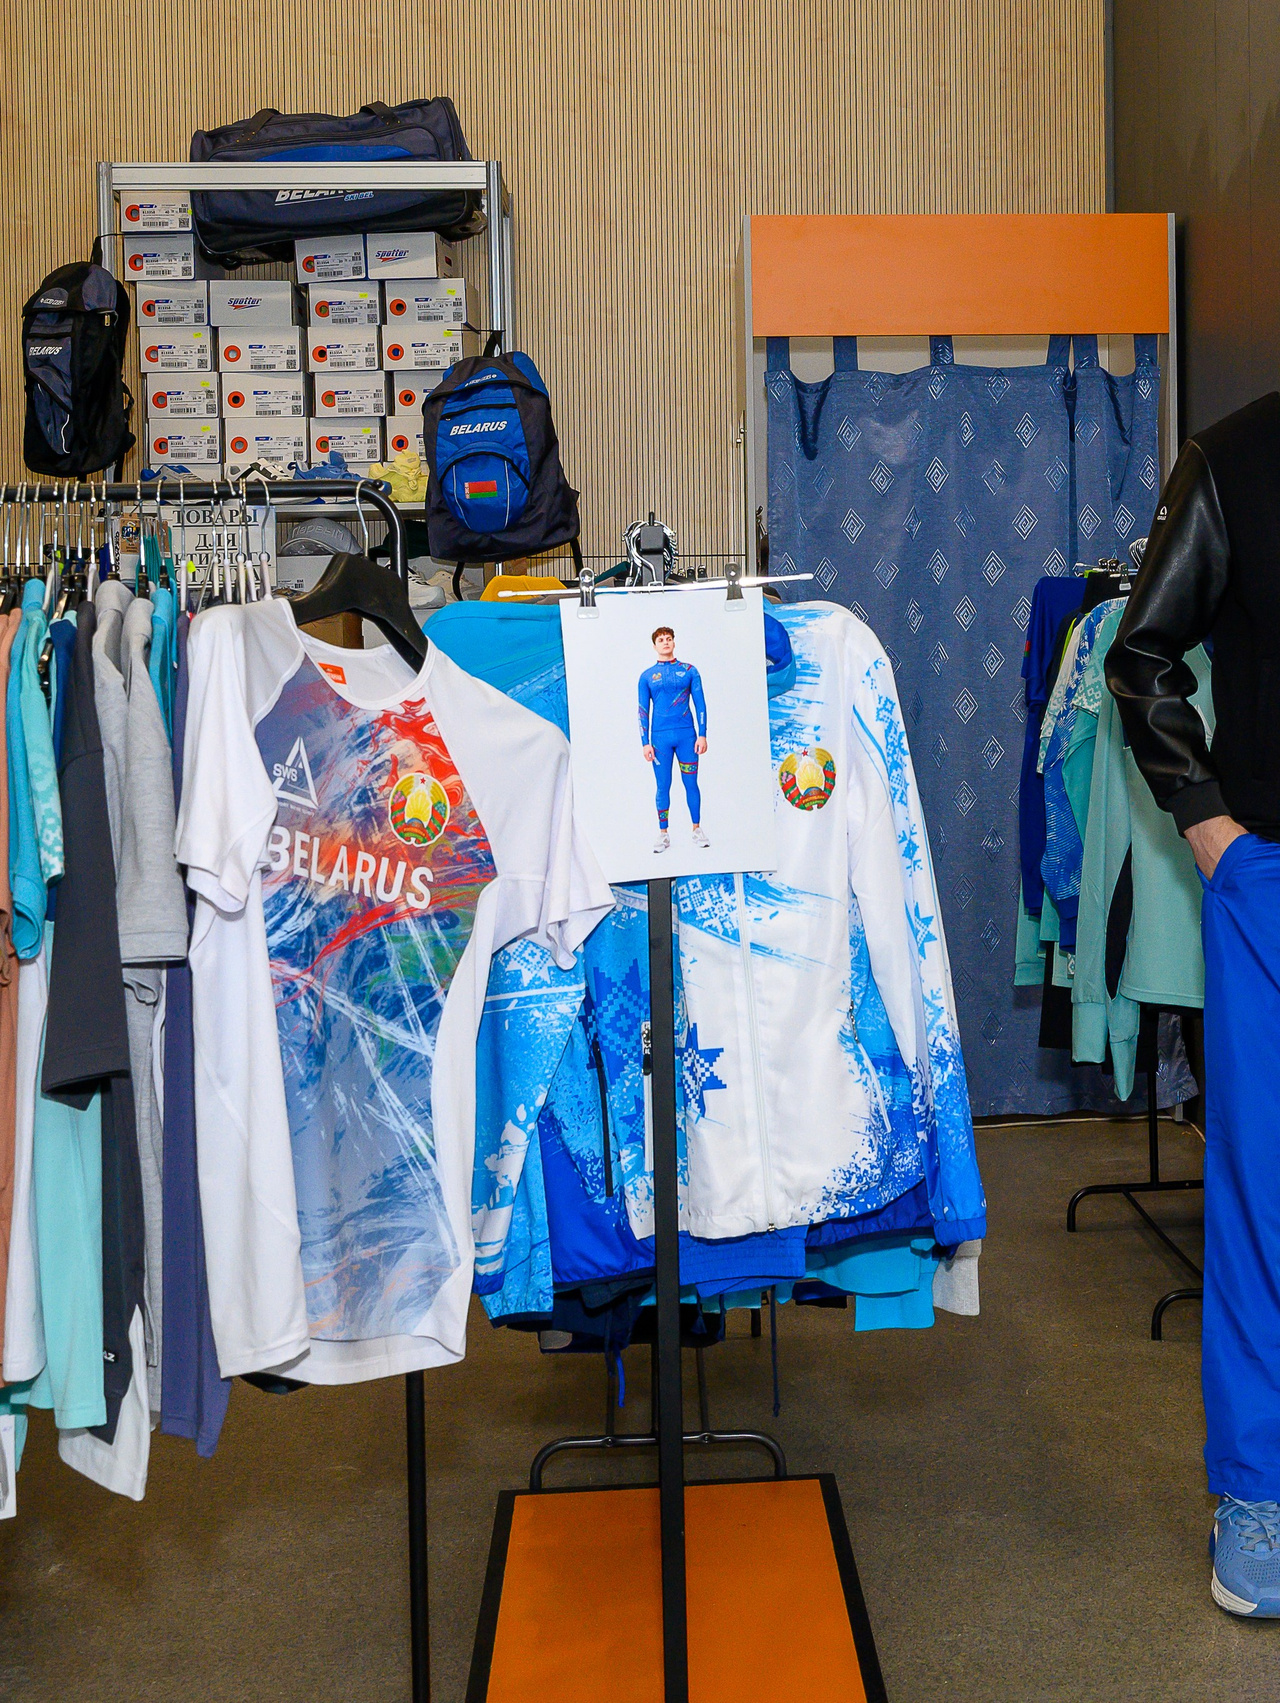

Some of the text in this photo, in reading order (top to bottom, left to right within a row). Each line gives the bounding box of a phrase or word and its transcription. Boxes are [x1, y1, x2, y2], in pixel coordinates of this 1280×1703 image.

[29, 346, 63, 356] BELARUS
[449, 421, 507, 436] BELARUS
[173, 509, 258, 523] ТОВАРЫ
[195, 533, 237, 549] ДЛЯ
[273, 763, 297, 781] SWS
[268, 825, 433, 910] BELARUS
